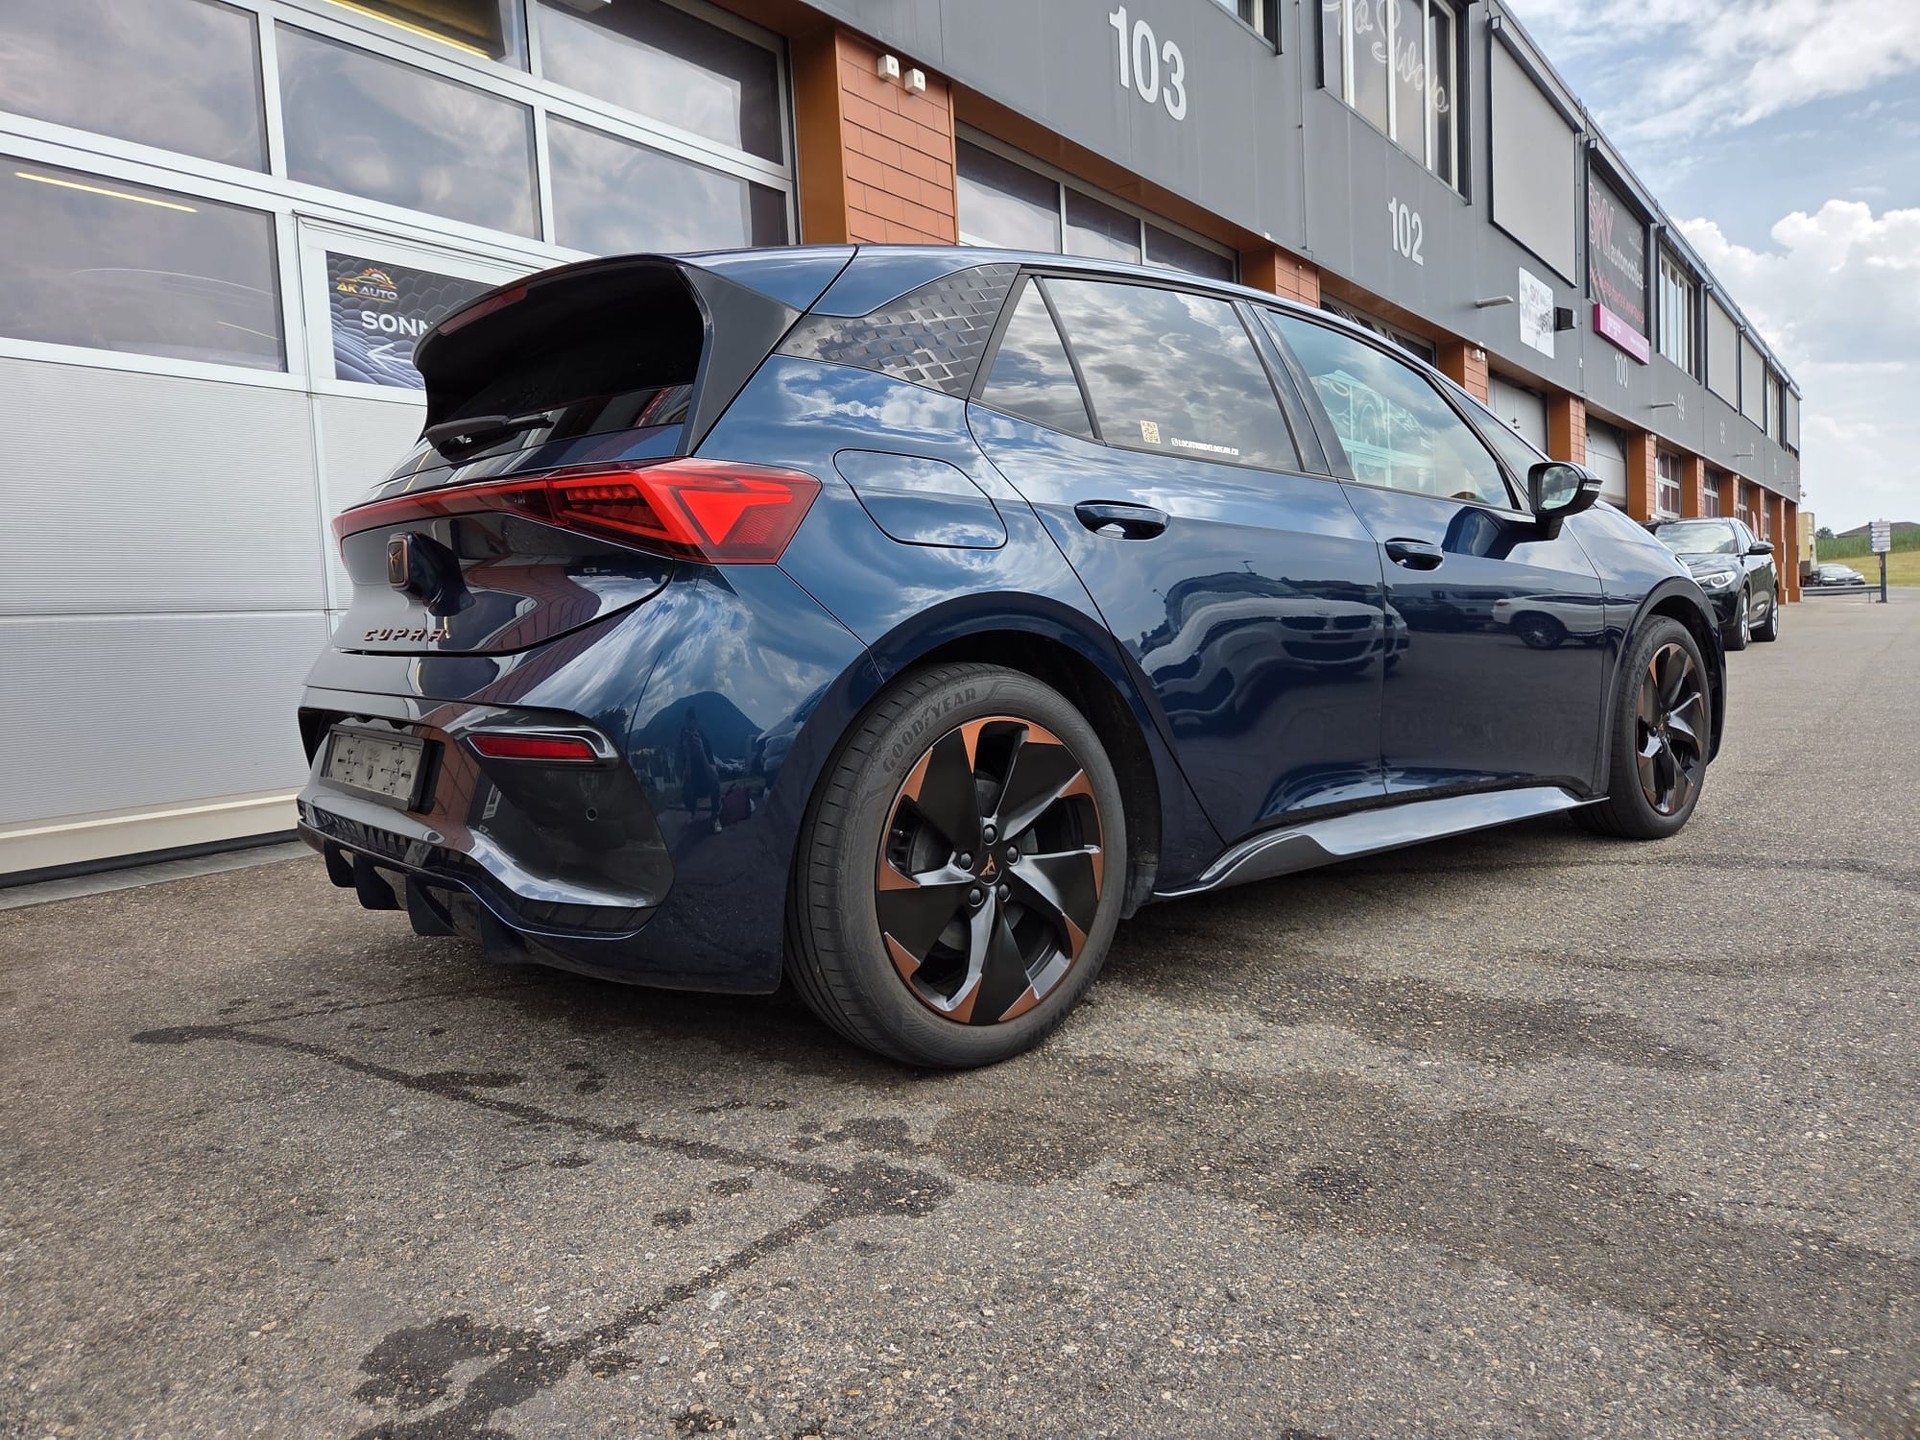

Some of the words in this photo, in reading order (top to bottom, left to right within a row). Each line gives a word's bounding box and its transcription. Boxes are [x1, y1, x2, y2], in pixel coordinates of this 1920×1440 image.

[1108, 4, 1187, 121] 103
[1387, 197, 1424, 266] 102
[336, 282, 358, 294] AK
[359, 285, 399, 301] AUTO
[1614, 350, 1629, 389] 100
[363, 627, 447, 643] CUPRA
[882, 687, 977, 774] GOODYEAR
